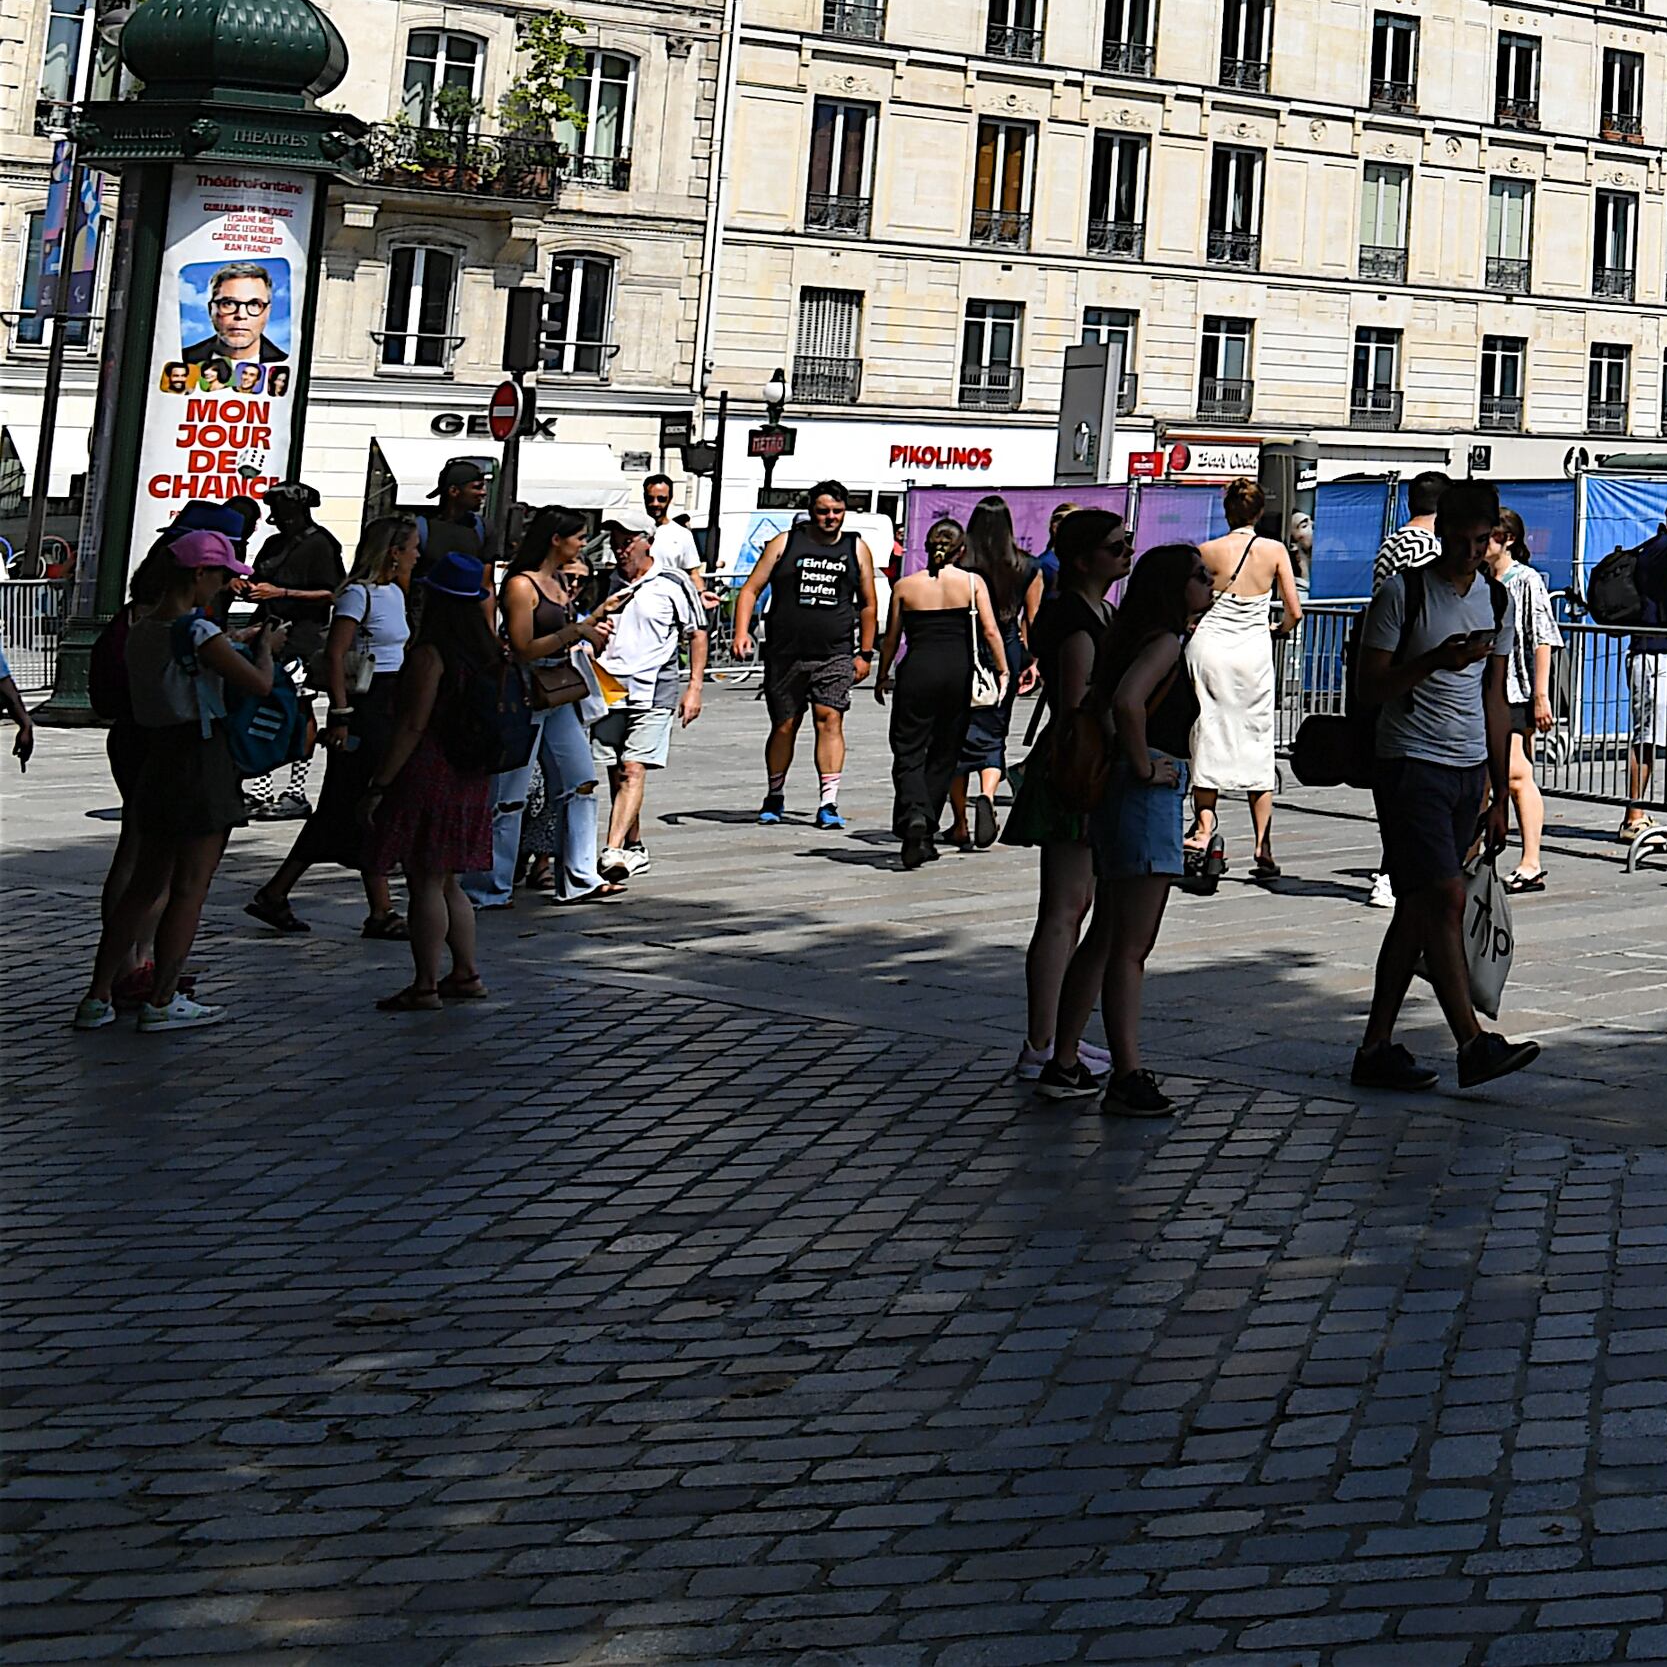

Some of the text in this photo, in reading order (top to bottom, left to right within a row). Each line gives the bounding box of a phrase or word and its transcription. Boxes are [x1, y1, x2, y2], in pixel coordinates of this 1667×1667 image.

[186, 398, 271, 424] MON
[176, 424, 272, 450] JOUR
[430, 413, 559, 441] GEX
[187, 449, 238, 474] DE
[888, 444, 993, 471] PIKOLINOS
[800, 582, 836, 596] laufen
[801, 569, 838, 583] besser
